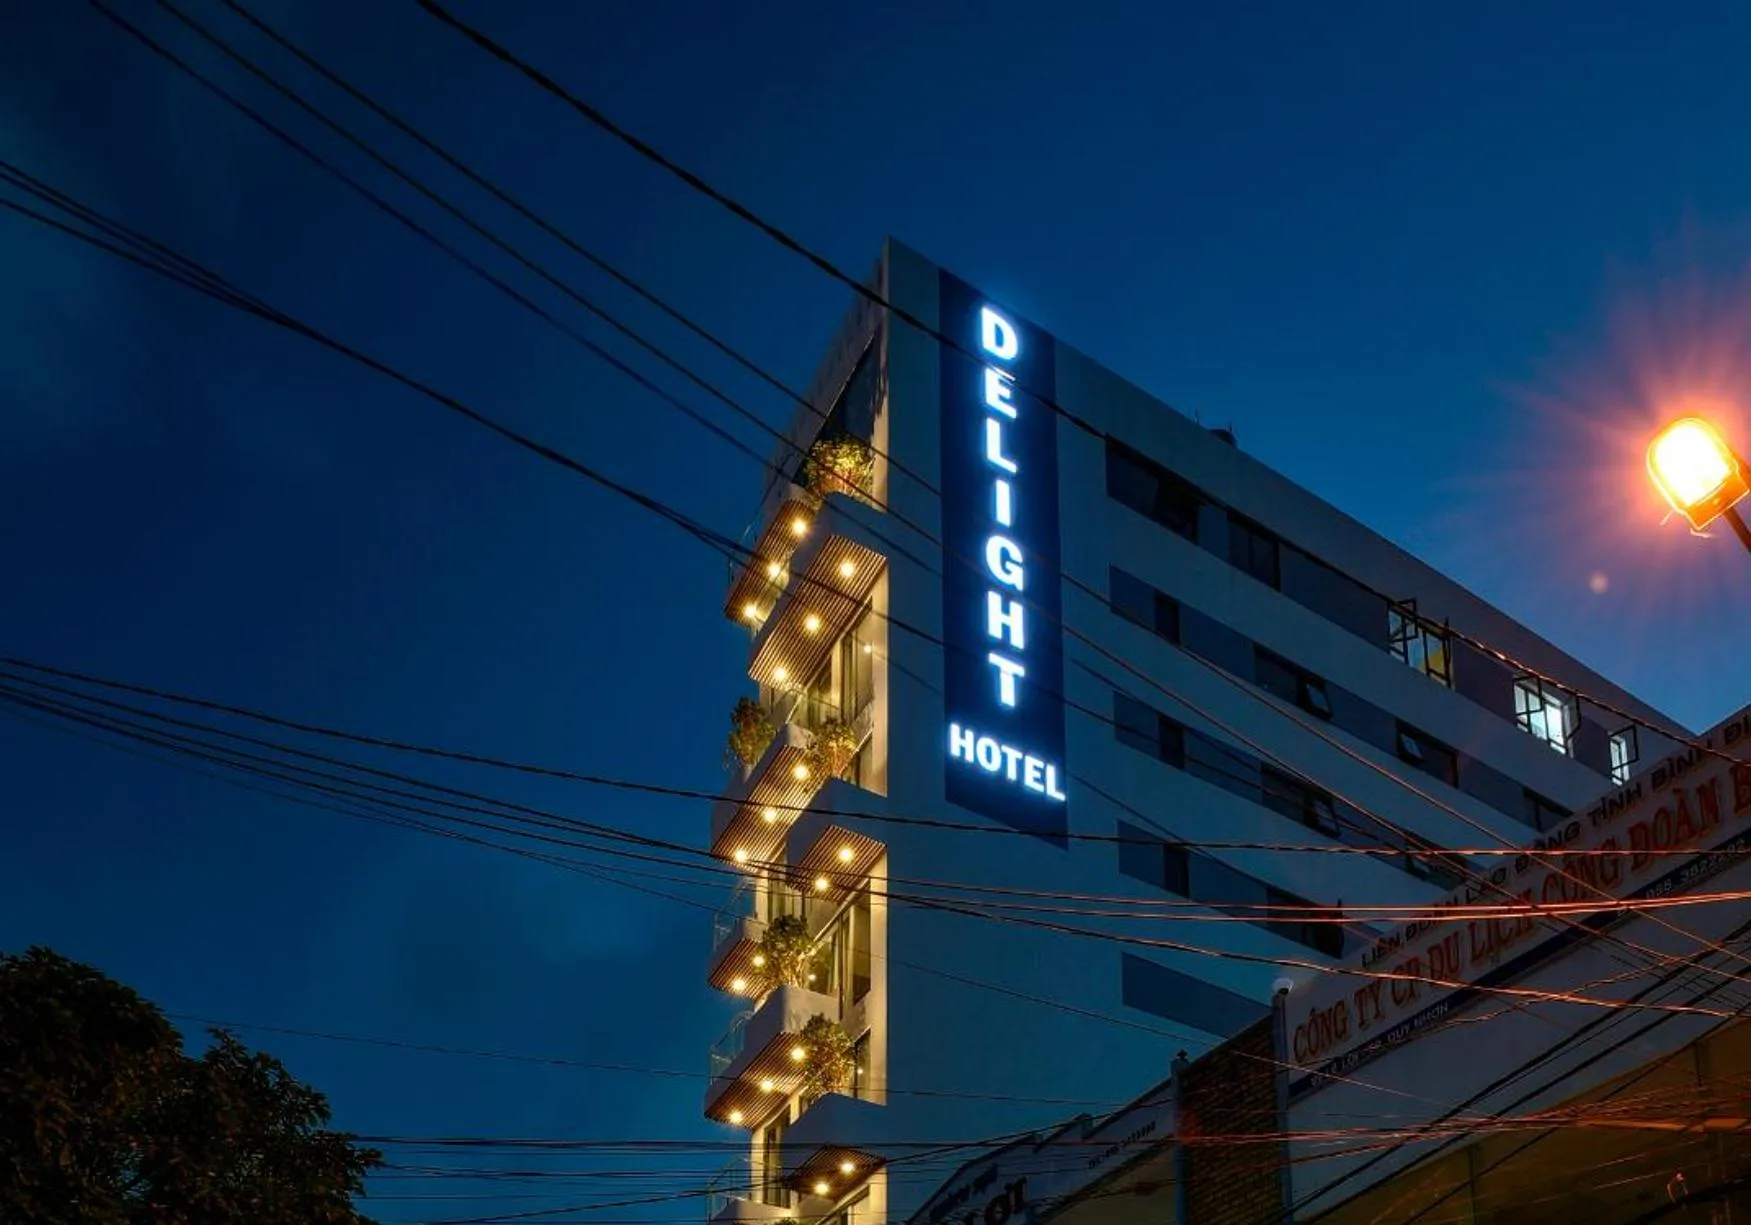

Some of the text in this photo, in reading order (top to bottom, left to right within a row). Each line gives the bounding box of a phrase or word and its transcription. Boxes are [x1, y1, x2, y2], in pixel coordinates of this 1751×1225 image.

[981, 306, 1023, 708] DELIGHT
[949, 721, 1066, 801] HOTEL
[1294, 1000, 1349, 1063] CÔNG
[1355, 977, 1386, 1029] TY
